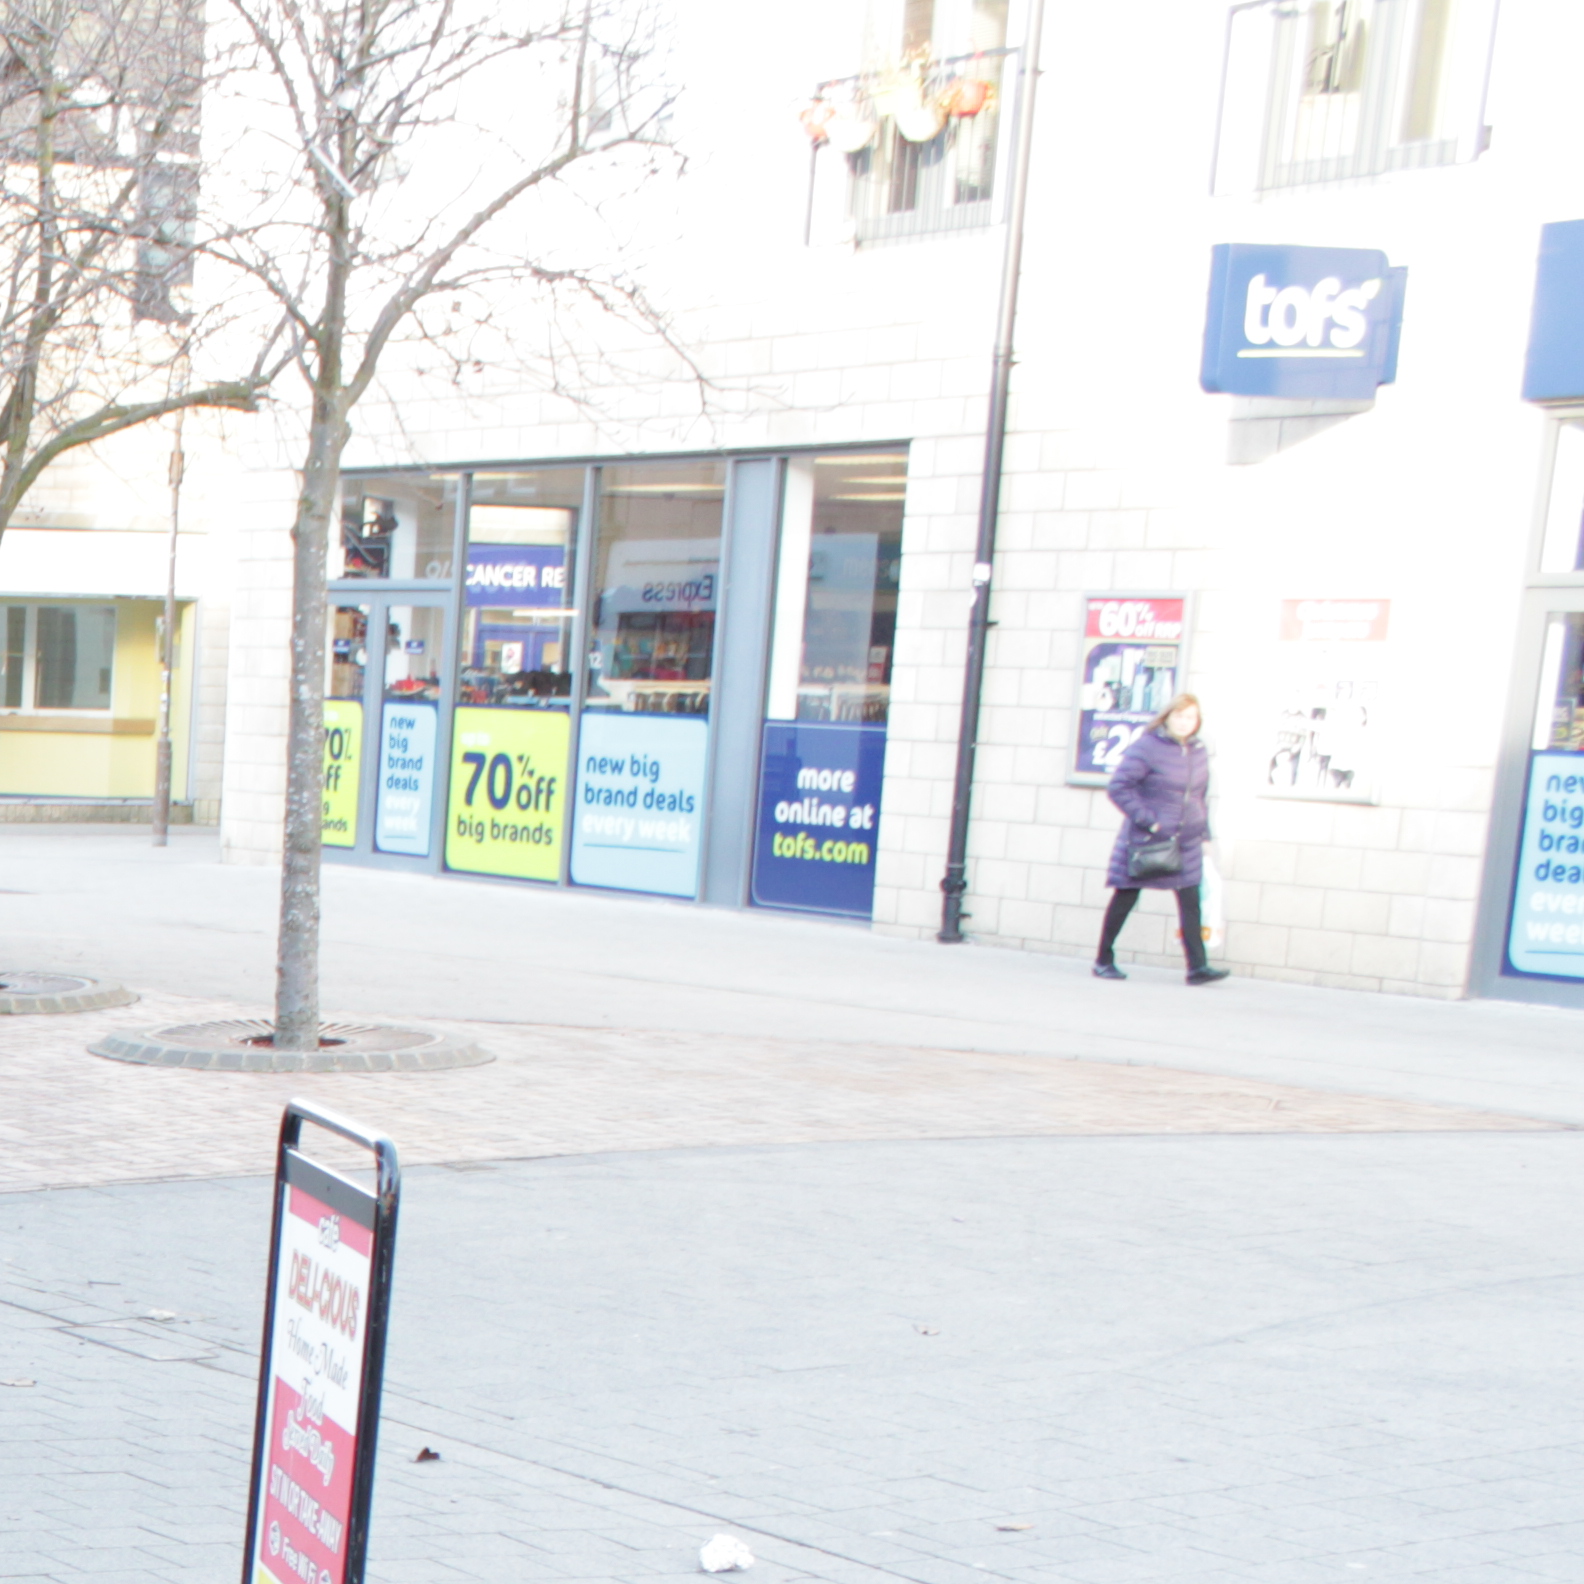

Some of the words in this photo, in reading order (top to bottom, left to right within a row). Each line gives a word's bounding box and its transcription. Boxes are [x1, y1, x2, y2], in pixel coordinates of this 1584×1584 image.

[1244, 273, 1372, 348] tofs
[390, 717, 415, 729] new
[389, 734, 408, 753] big
[388, 754, 423, 771] brand
[586, 755, 625, 775] new
[630, 754, 660, 783] big
[325, 764, 342, 792] ff
[386, 774, 419, 791] deals
[797, 767, 855, 793] more
[516, 776, 557, 813] off
[584, 782, 638, 809] brand
[643, 787, 695, 813] deals
[582, 813, 636, 842] every
[638, 818, 691, 843] week
[775, 797, 846, 828] online
[849, 804, 874, 830] at
[457, 814, 484, 844] big
[491, 817, 553, 846] brands
[1538, 829, 1584, 854] bra
[773, 831, 869, 865] tofs.com
[288, 1248, 360, 1342] DELI-CIOUS
[282, 1537, 299, 1571] Free
